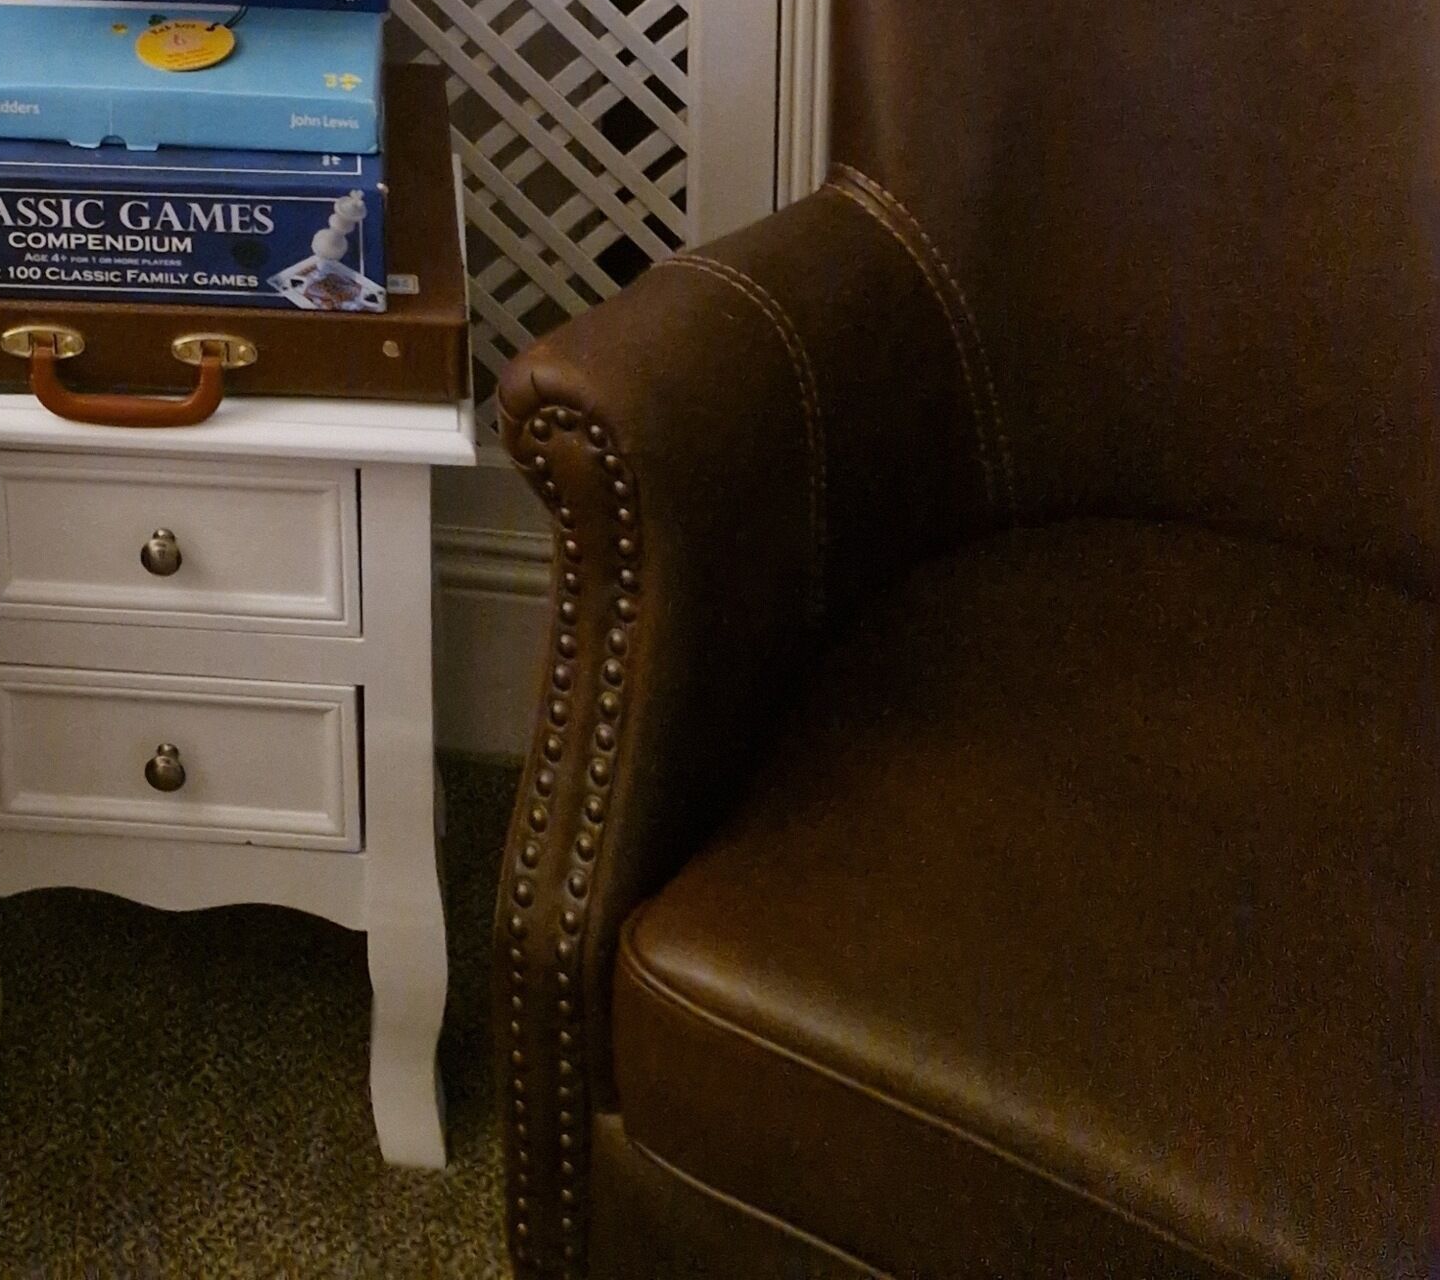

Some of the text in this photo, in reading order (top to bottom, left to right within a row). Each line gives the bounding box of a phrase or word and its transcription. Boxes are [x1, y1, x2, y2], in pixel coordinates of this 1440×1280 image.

[290, 112, 359, 129] John Lewis
[119, 200, 275, 235] GAMES
[8, 231, 192, 253] COMPENDIUM
[24, 252, 49, 263] AGE
[50, 252, 68, 264] 4+
[71, 256, 89, 264] FOR
[98, 257, 112, 265] OR
[113, 258, 139, 266] MORE
[141, 258, 182, 267] PLAYERS
[8, 266, 41, 280] 100
[45, 267, 122, 282] CLASSIC
[126, 269, 189, 285] FAMILY
[193, 271, 259, 287] GAMES
